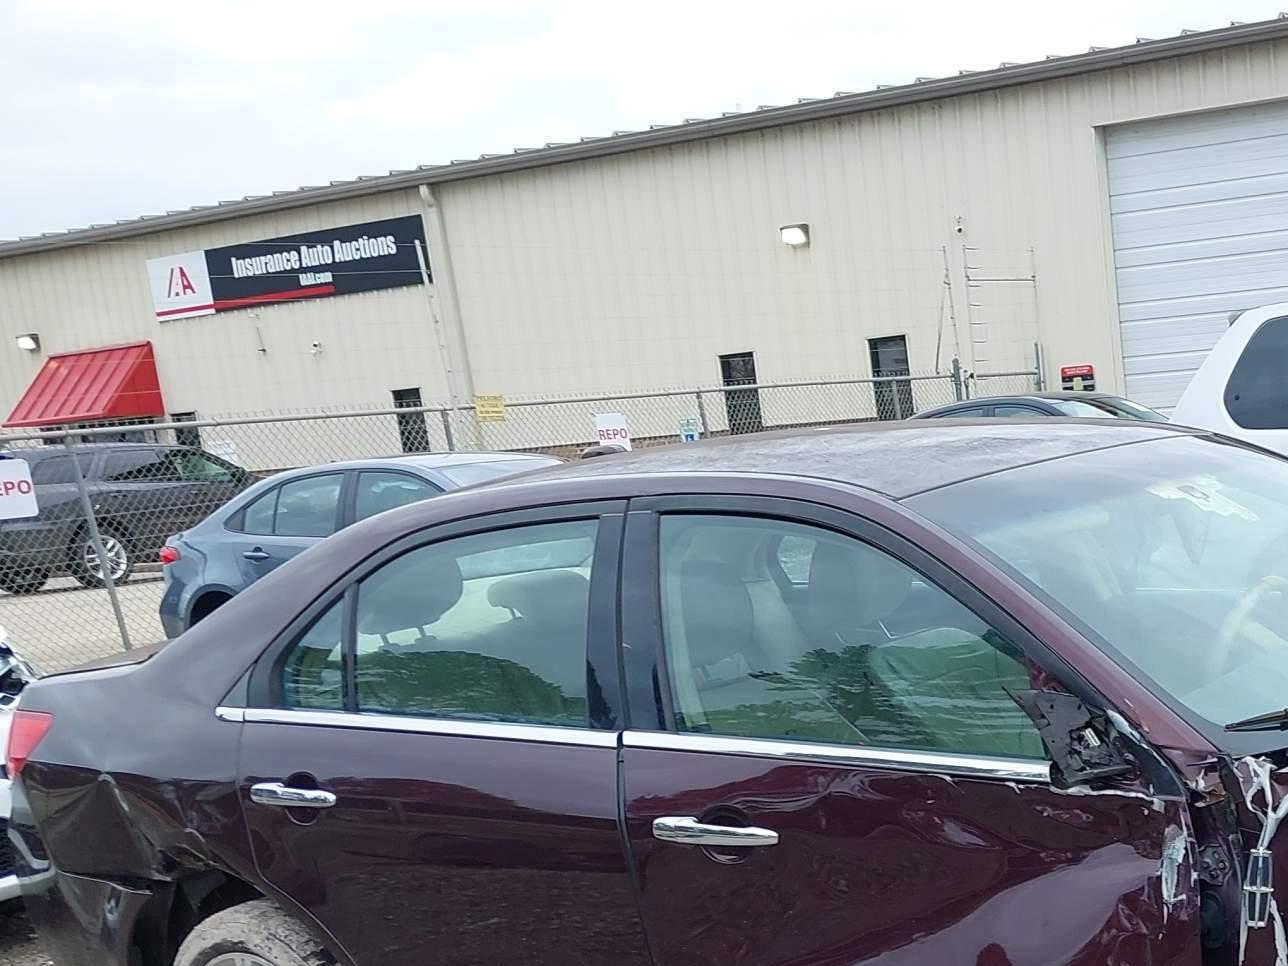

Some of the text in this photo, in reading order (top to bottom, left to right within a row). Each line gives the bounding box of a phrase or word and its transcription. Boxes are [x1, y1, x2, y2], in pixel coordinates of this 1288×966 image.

[230, 234, 397, 278] Insurance Auto Auctions
[598, 428, 628, 440] REPO
